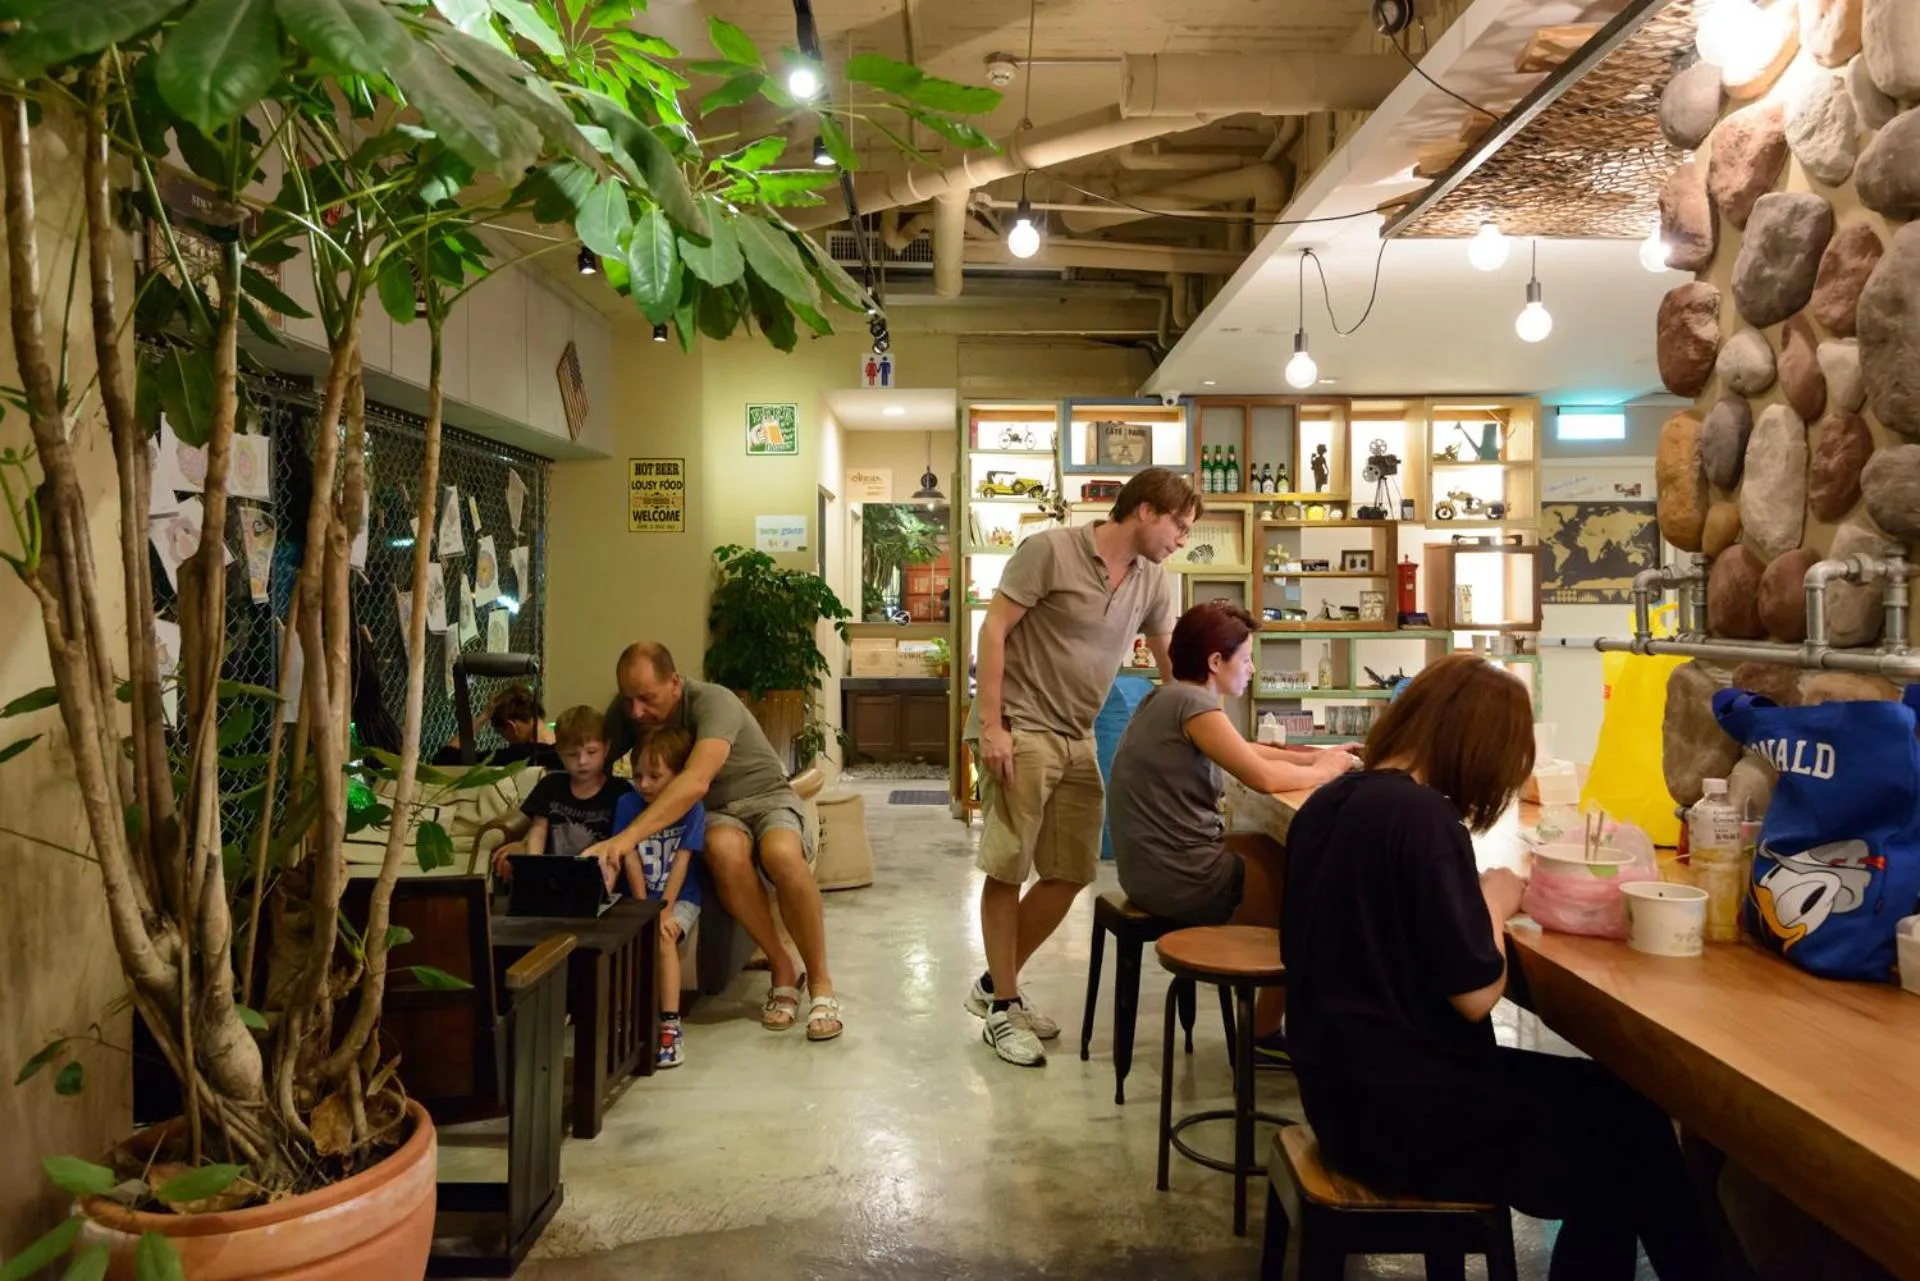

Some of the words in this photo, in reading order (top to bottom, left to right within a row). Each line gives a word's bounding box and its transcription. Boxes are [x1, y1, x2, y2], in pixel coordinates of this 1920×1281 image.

[635, 463, 653, 475] HOT
[655, 463, 679, 475] BEER
[631, 480, 657, 490] LOUSY
[659, 479, 683, 490] FOOD
[632, 510, 680, 521] WELCOME
